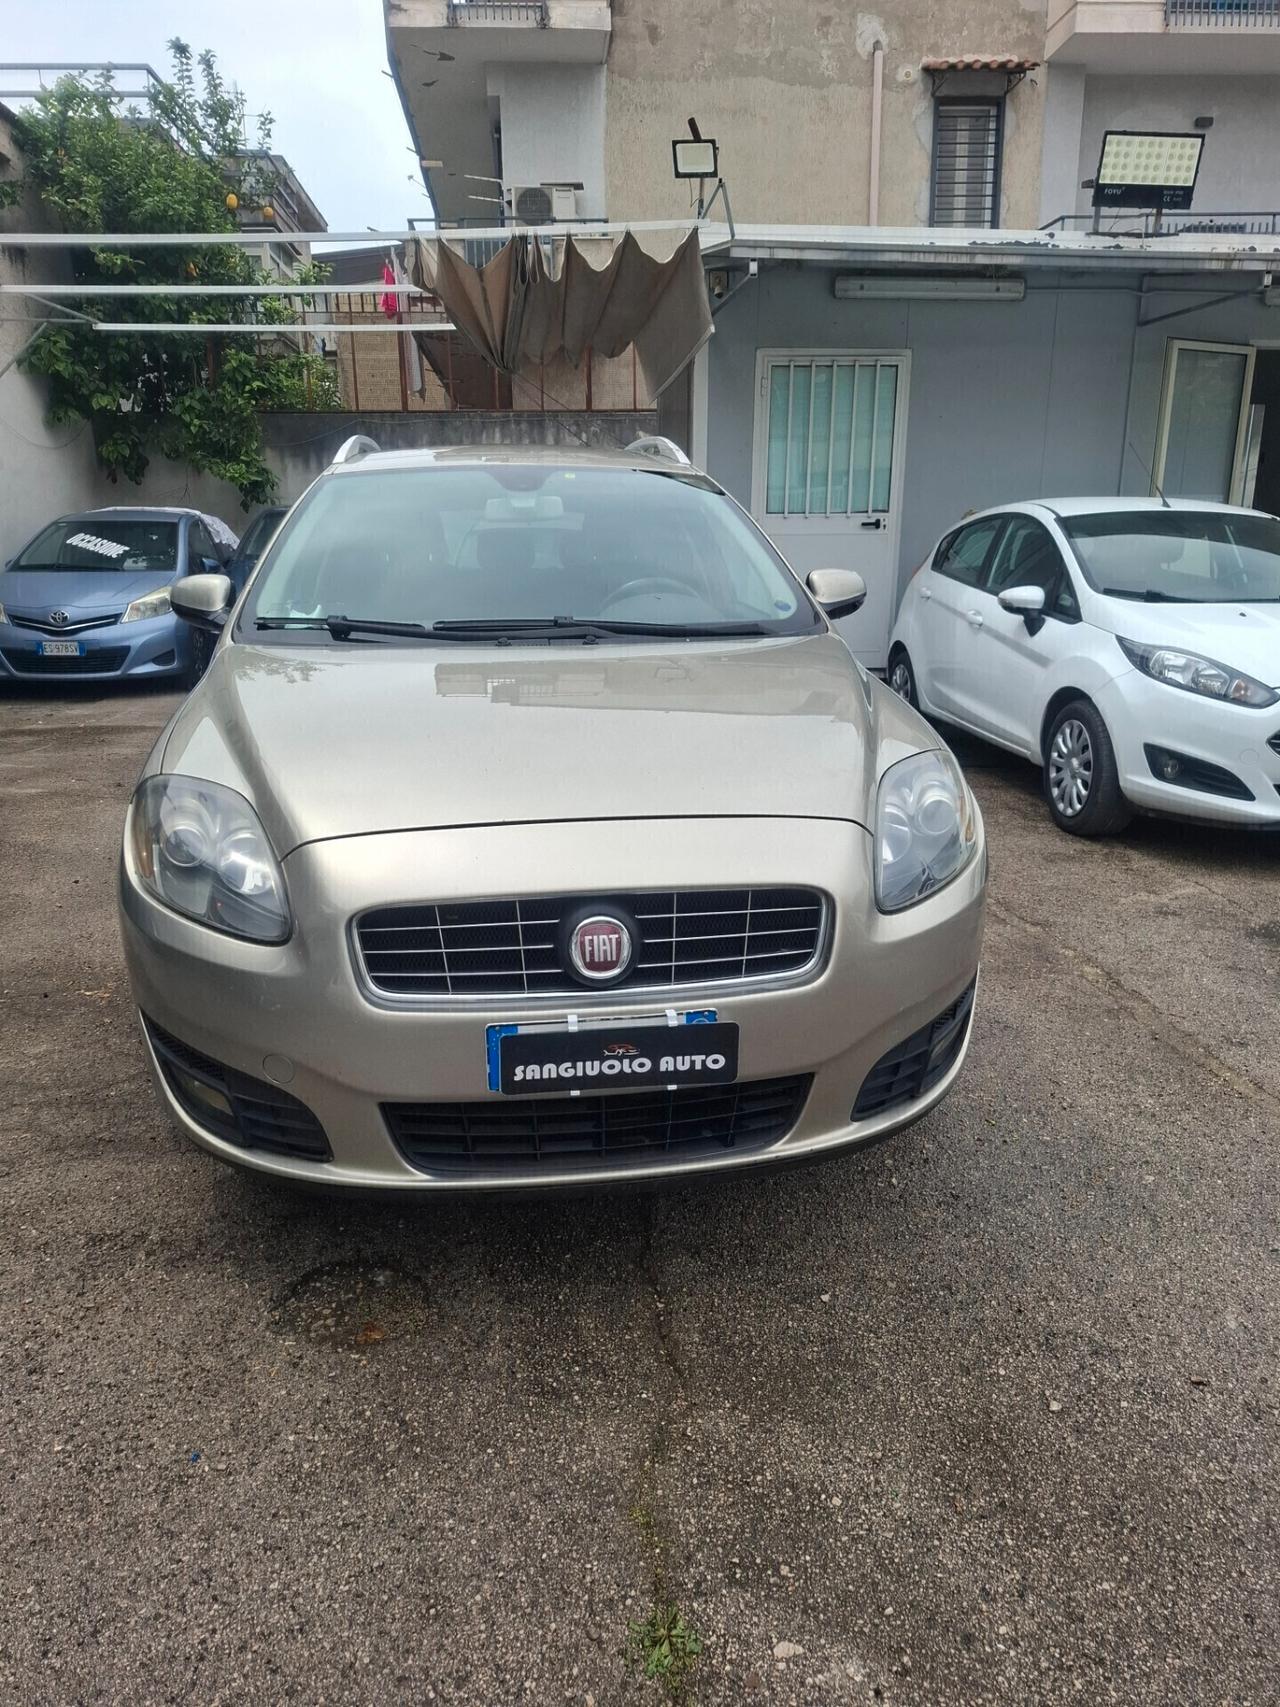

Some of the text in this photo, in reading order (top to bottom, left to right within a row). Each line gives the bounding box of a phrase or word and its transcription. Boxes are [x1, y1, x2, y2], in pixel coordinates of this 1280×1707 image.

[65, 532, 131, 558] OCCASIONE
[584, 934, 619, 962] FIAT
[513, 1053, 726, 1081] SANGIUOLO AUTO
